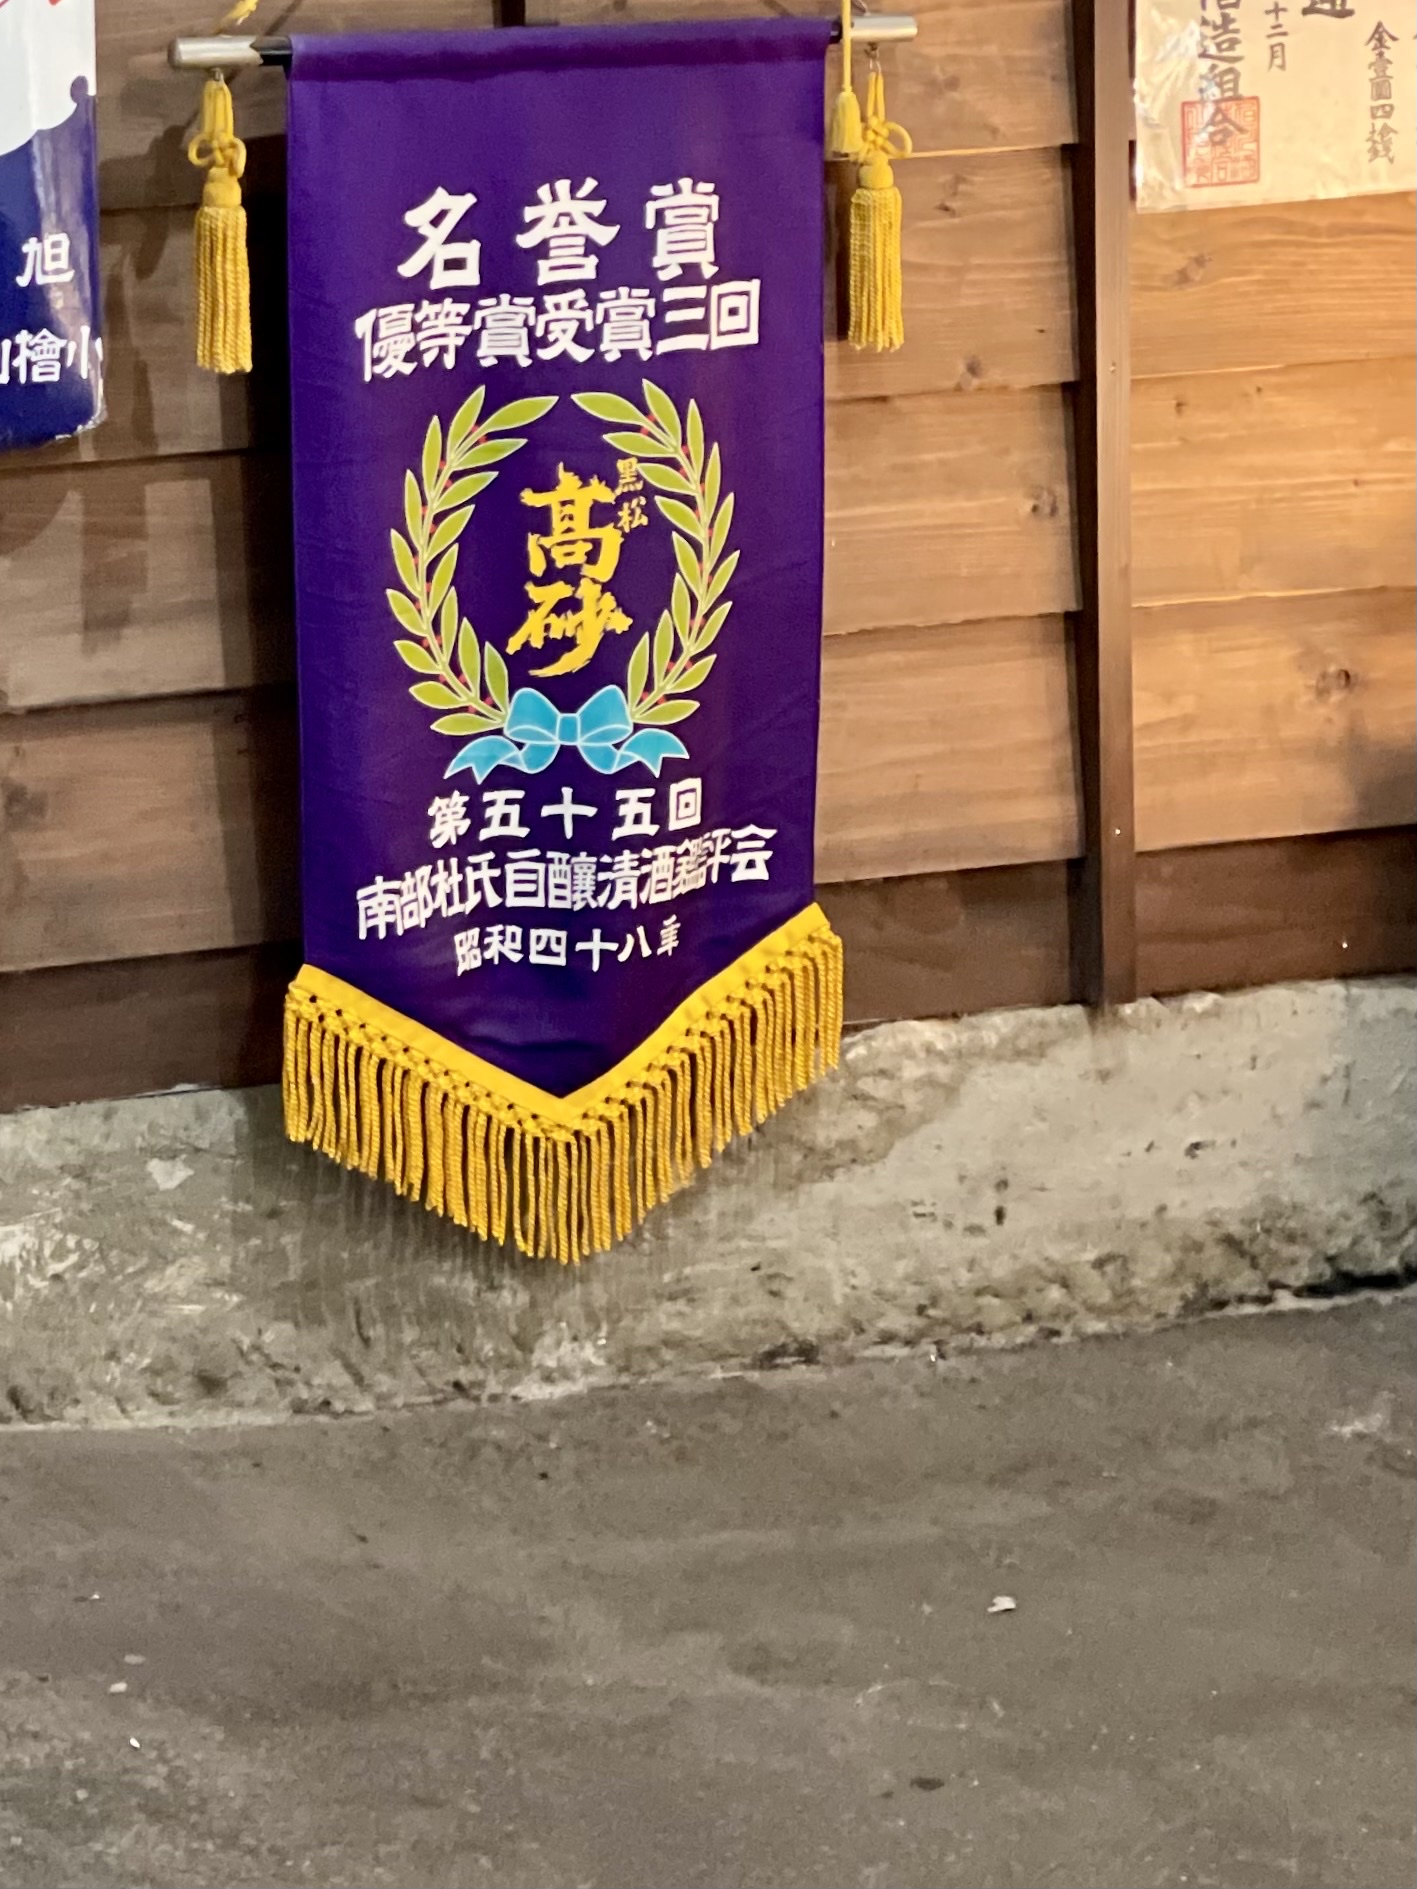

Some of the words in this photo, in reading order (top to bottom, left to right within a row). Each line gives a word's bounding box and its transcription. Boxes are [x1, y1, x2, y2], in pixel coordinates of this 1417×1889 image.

[397, 177, 720, 290] 名誉賞
[354, 278, 761, 383] 優等賞受賞三回
[427, 777, 702, 848] 第五十五回
[454, 913, 682, 977] 昭和四十八年
